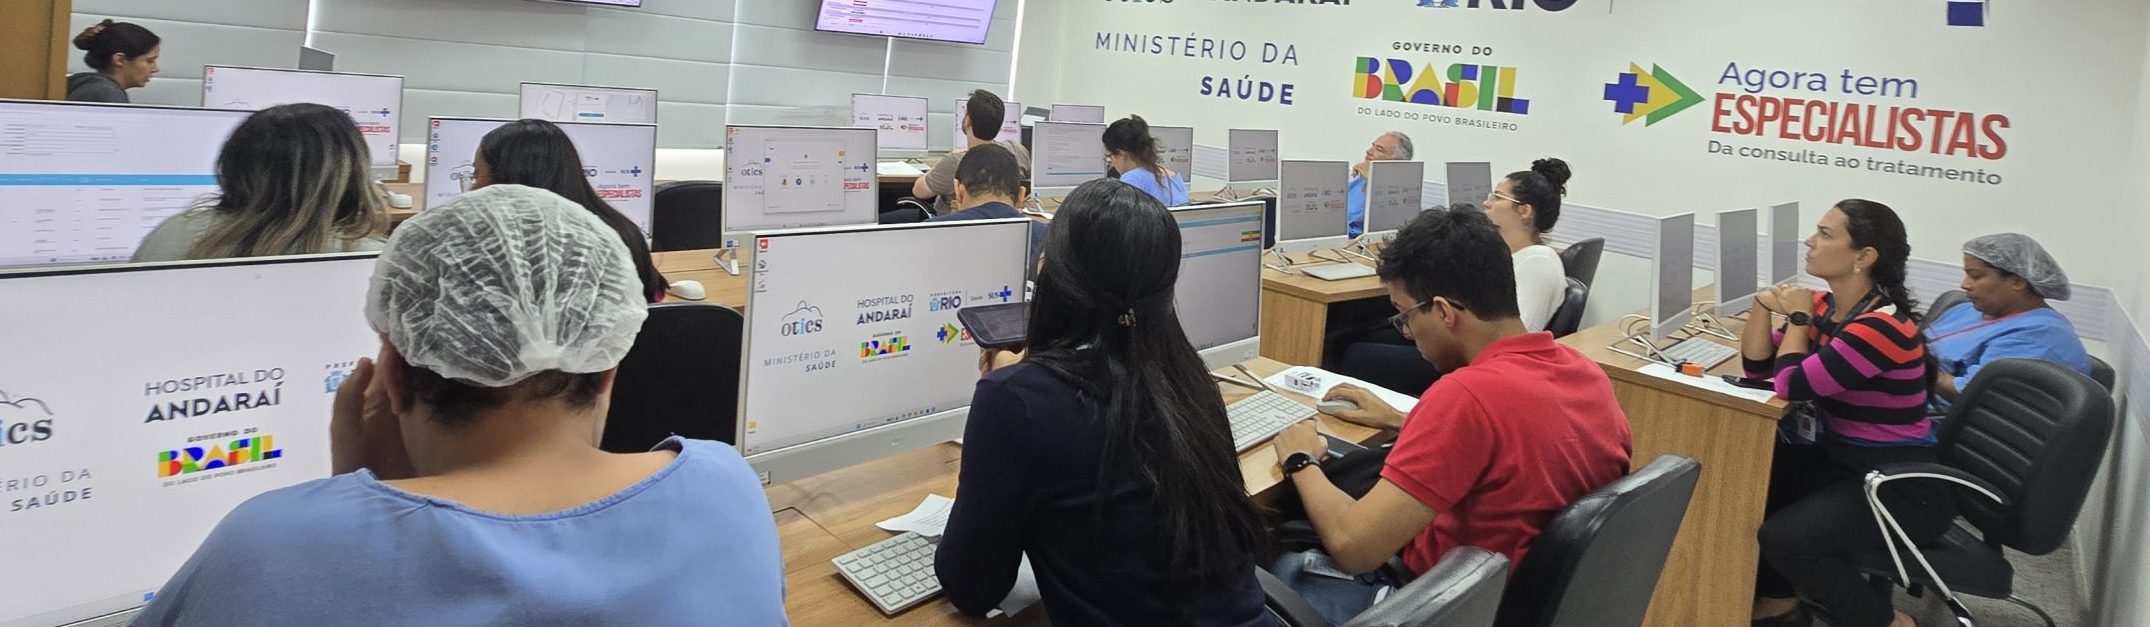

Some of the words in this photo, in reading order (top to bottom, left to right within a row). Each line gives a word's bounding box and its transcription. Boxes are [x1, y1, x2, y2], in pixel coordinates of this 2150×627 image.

[1095, 31, 1247, 61] MINISTÉRIO
[1262, 42, 1298, 65] DA
[1392, 41, 1462, 54] GOVERNO
[1471, 46, 1493, 56] DO
[1200, 75, 1294, 105] SAÚDE
[1352, 56, 1530, 115] BRASIL
[1718, 61, 1828, 94] Agora
[1840, 68, 1919, 98] tem
[1357, 106, 1372, 115] DO
[1375, 108, 1401, 118] LADO
[1404, 111, 1419, 120] DO
[1422, 114, 1451, 124] POVO
[1455, 117, 1518, 131] BRASILEIRO
[1711, 92, 2011, 160] ESPECIALISTAS
[1708, 139, 1733, 155] Da
[1738, 144, 1829, 166] consulta
[1834, 155, 1860, 169] ao
[1866, 156, 2002, 185] tratamento
[856, 303, 913, 325] ANDARAÍ
[857, 296, 899, 308] HOSPITAL
[900, 294, 914, 303] DO
[940, 295, 962, 310] RIO
[781, 318, 823, 337] otics
[860, 336, 911, 358] BRASIL
[805, 360, 836, 372] SAÚDE
[144, 371, 249, 396] HOSPITAL
[254, 367, 285, 383] DO
[143, 381, 285, 423] ANDARAÍ
[0, 418, 54, 447] ics
[157, 434, 283, 478] BRASIL
[61, 468, 92, 483] DA
[10, 487, 93, 512] SAÚDE
